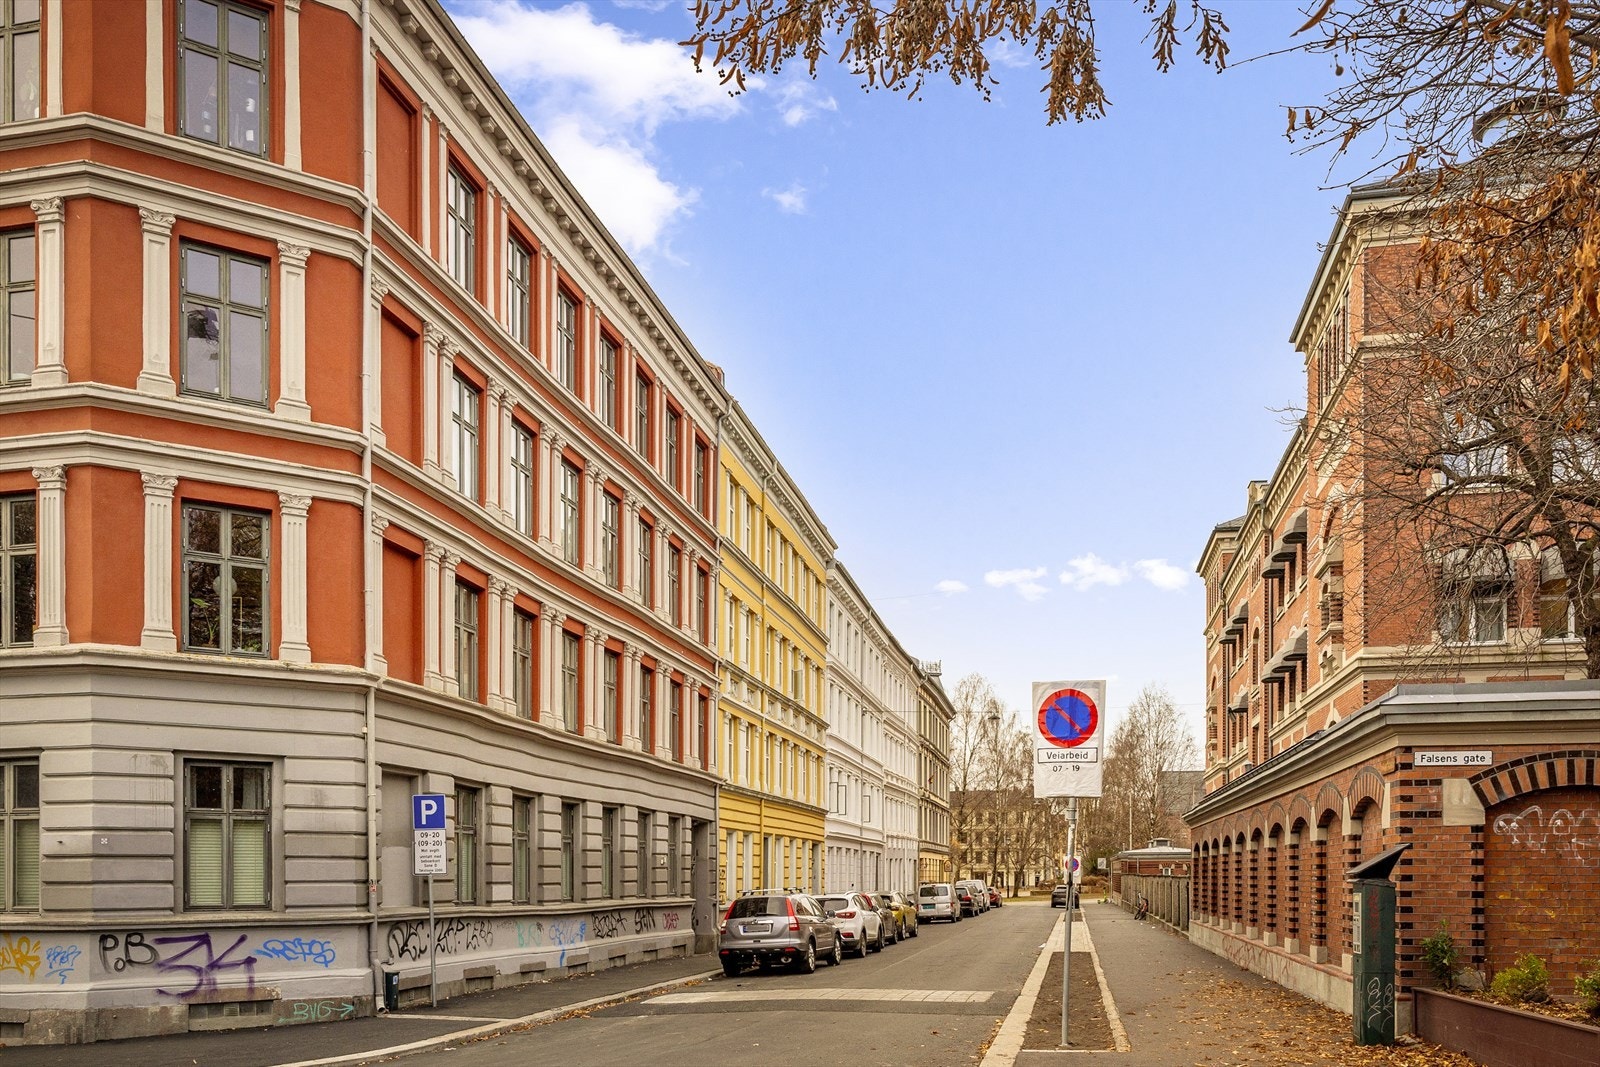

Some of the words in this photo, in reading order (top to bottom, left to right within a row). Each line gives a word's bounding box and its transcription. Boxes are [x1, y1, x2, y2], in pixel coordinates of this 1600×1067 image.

[1046, 751, 1089, 760] Veiarbeid
[1420, 754, 1458, 763] Falsens
[1463, 754, 1486, 764] gate
[421, 799, 438, 825] P
